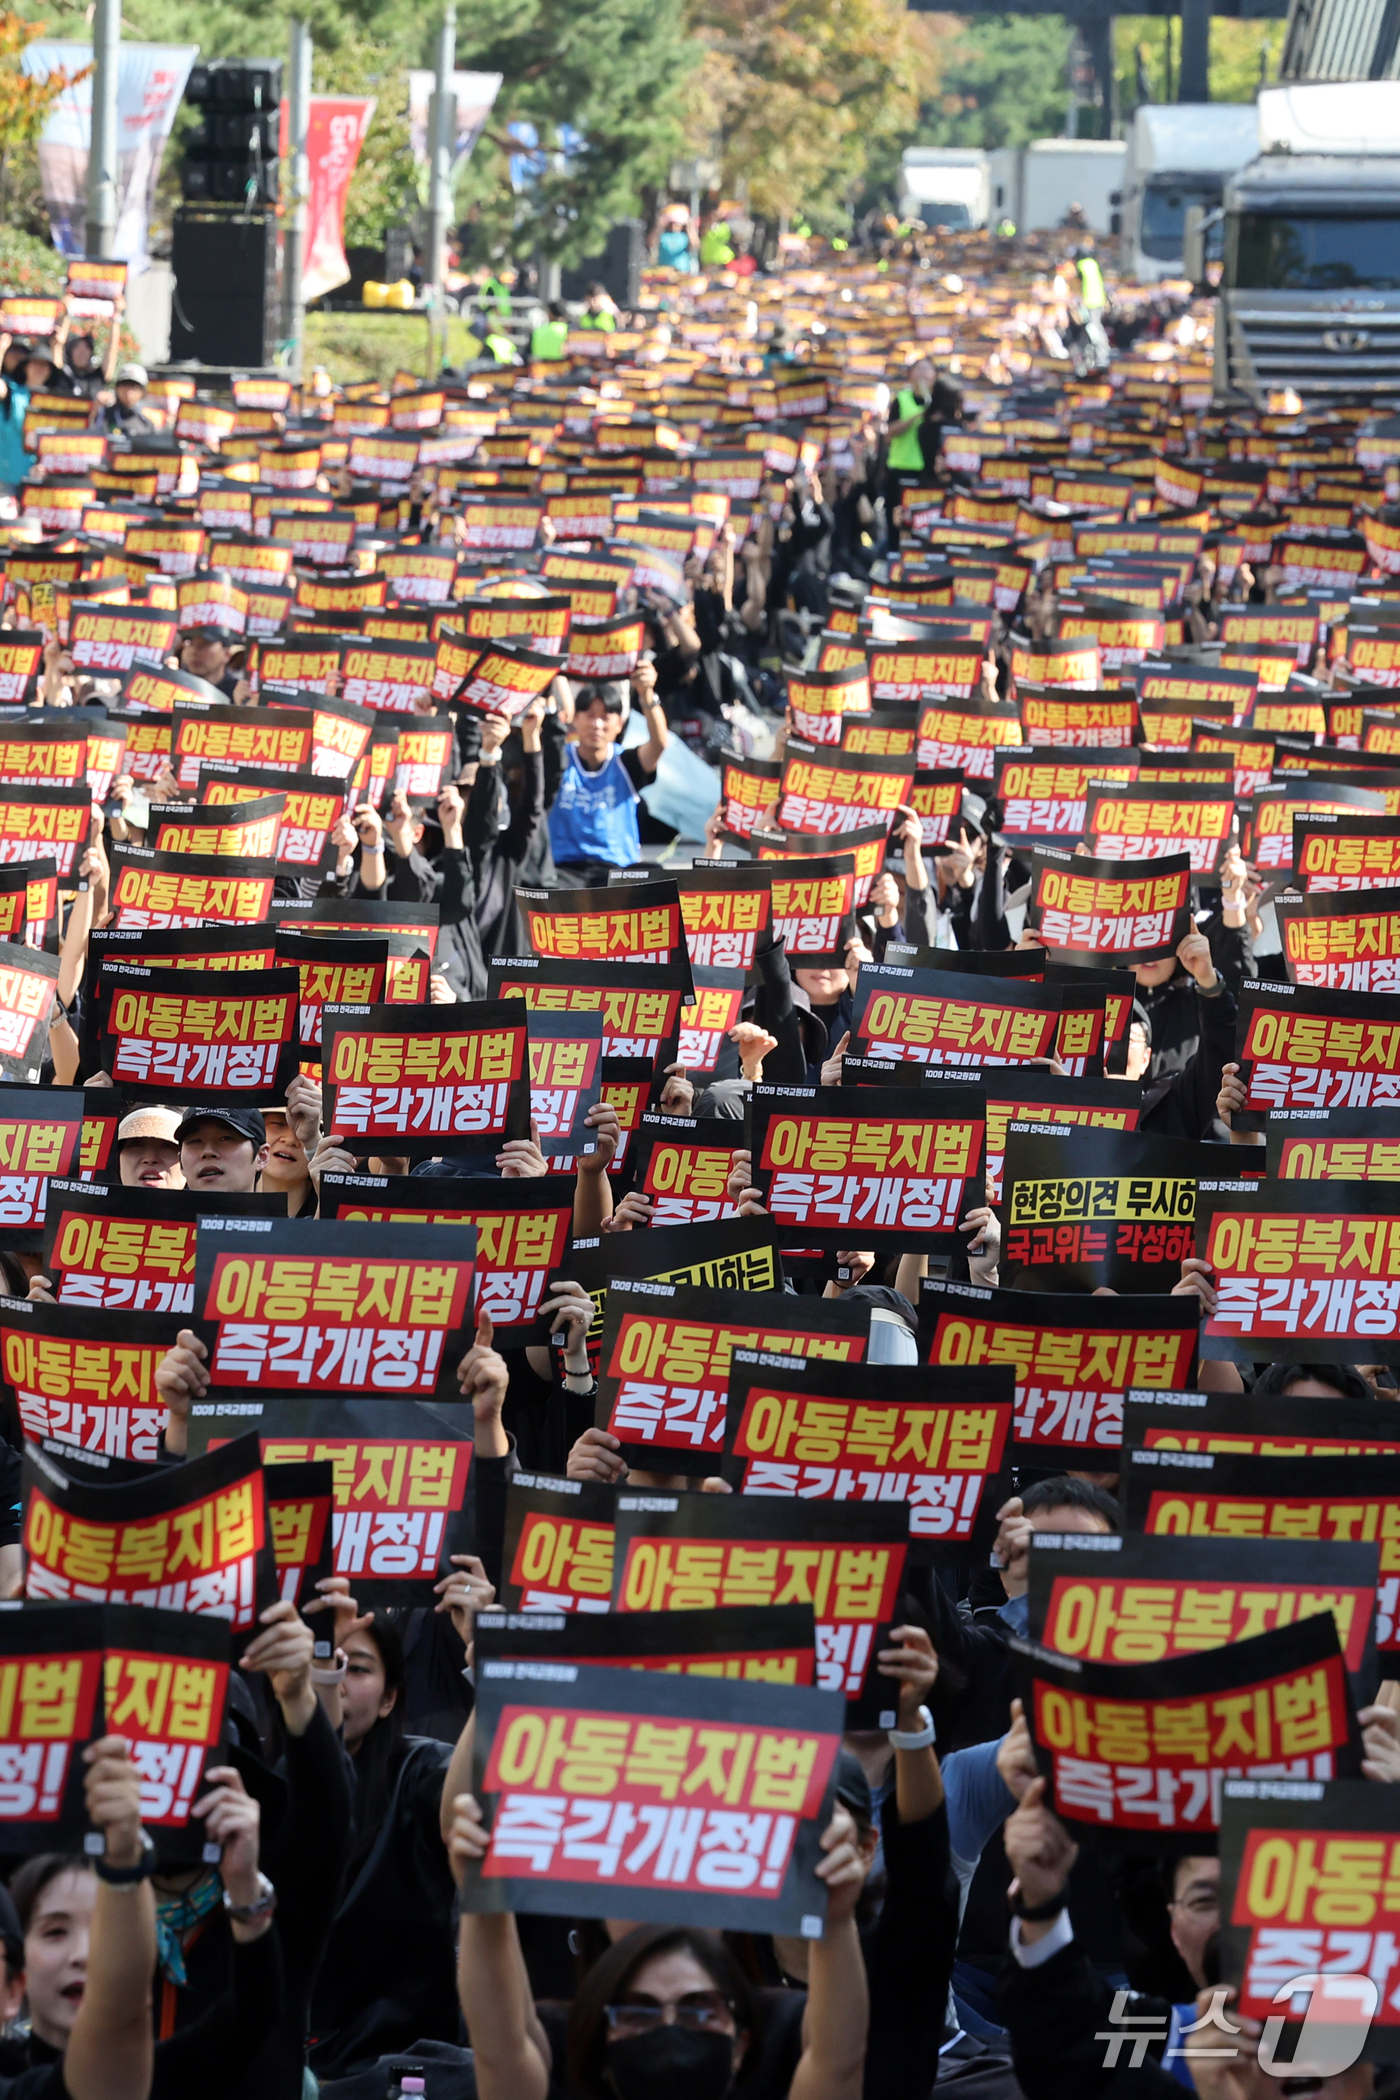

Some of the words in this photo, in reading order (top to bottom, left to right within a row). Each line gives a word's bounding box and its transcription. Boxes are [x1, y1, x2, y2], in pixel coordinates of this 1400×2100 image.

[74, 616, 171, 648] 아동복지법
[469, 611, 568, 636] 아동복지법
[263, 653, 339, 678] 아동복지
[478, 653, 556, 692] 아동복지법
[873, 656, 977, 683] 아동복지법
[921, 711, 1022, 746] 아동복지법
[1026, 701, 1132, 728] 아동복지법
[0, 744, 79, 775] 복지법
[181, 723, 305, 762] 아동복지법
[845, 730, 915, 755] 아동복
[726, 770, 780, 807] 아동복
[786, 762, 906, 808] 아동복지법
[0, 805, 82, 840] 복지법
[1004, 800, 1087, 832] 즉각개
[1096, 803, 1225, 837] 아동복지법
[114, 845, 127, 853] 1009
[161, 818, 276, 856] 아동복지법
[1094, 835, 1219, 870] 즉각개정!
[1306, 838, 1400, 874] 아동복
[119, 871, 264, 918] 아동복지법
[286, 900, 312, 908] 전국교원집회
[680, 894, 761, 930] 복지법
[771, 879, 845, 915] 복지법
[1042, 873, 1181, 915] 아동복지법
[92, 932, 106, 940] 1009
[108, 931, 142, 939] 전국교원집회
[532, 909, 670, 953] 아동복지법
[772, 917, 839, 951] 개정!
[1041, 909, 1172, 949] 즉각개정!
[492, 958, 506, 966] 1009
[507, 958, 539, 968] 전국교원집회
[686, 932, 757, 967] 개정!
[102, 962, 116, 971] 1009
[118, 964, 151, 976] 전국교원집회
[861, 964, 876, 972] 1009
[877, 966, 913, 976] 전국교원집회
[1244, 980, 1258, 990] 1009
[1260, 982, 1294, 994] 전국교원집회
[116, 993, 287, 1041] 아동복지법
[324, 1004, 338, 1013] 1009
[340, 1005, 370, 1014] 전국교원집회
[868, 995, 1047, 1054] 아동복지법
[335, 1032, 515, 1084] 아동복지법
[1251, 1014, 1400, 1070] 아동복지
[116, 1038, 278, 1086] 즉각개정!
[845, 1058, 860, 1066] 1009
[862, 1059, 895, 1069] 전국교원집회
[925, 1070, 941, 1079] 1009
[943, 1071, 981, 1081] 전국교원집회
[334, 1083, 508, 1132] 즉각개정!
[756, 1086, 774, 1095] 1009
[776, 1088, 815, 1097] 전국교원집회
[643, 1114, 659, 1123] 1009
[661, 1115, 697, 1128] 전국교원집회
[1010, 1123, 1029, 1132] 1009
[1030, 1125, 1071, 1136] 전국교원집회
[1270, 1110, 1288, 1118] 1009
[1290, 1110, 1329, 1119] 전국교원집회
[770, 1120, 972, 1175] 아동복지법
[1286, 1143, 1400, 1180] 아동복
[51, 1179, 68, 1190] 1009
[70, 1183, 108, 1195] 전국교원집회
[324, 1173, 342, 1183] 1009
[344, 1175, 387, 1187] 전국교원집회
[1199, 1182, 1216, 1190] 1009
[1219, 1182, 1258, 1191] 전국교원집회
[770, 1173, 959, 1227] 즉각개정!
[1015, 1180, 1119, 1220] 현장의견
[1127, 1181, 1195, 1218] 무시하
[201, 1219, 223, 1230] 1009
[225, 1220, 272, 1231] 전국교원집회
[573, 1237, 599, 1249] 교원집회
[60, 1218, 196, 1277] 아동복
[1007, 1225, 1107, 1266] 국교위는
[1116, 1225, 1195, 1263] 각성하
[1213, 1218, 1400, 1274] 아동복지
[216, 1259, 457, 1325] 아동복지법
[611, 1280, 631, 1290] 1009
[633, 1283, 675, 1296] 전국교원집회
[923, 1280, 944, 1290] 1009
[1214, 1278, 1400, 1334] 즉각개정
[216, 1323, 442, 1388] 즉각개정!
[938, 1321, 1181, 1388] 아동복지법
[18, 1391, 170, 1460] 즉각개정
[745, 1396, 997, 1470] 아동복지법
[264, 1445, 456, 1506] 복지법
[29, 1482, 254, 1583] 아동복지법
[332, 1512, 444, 1573] 개정!
[626, 1544, 889, 1617] 아동복지법
[1042, 1669, 1331, 1763] 아동복지법
[502, 1713, 816, 1811] 아동복지법
[490, 1795, 795, 1889] 즉각개정!
